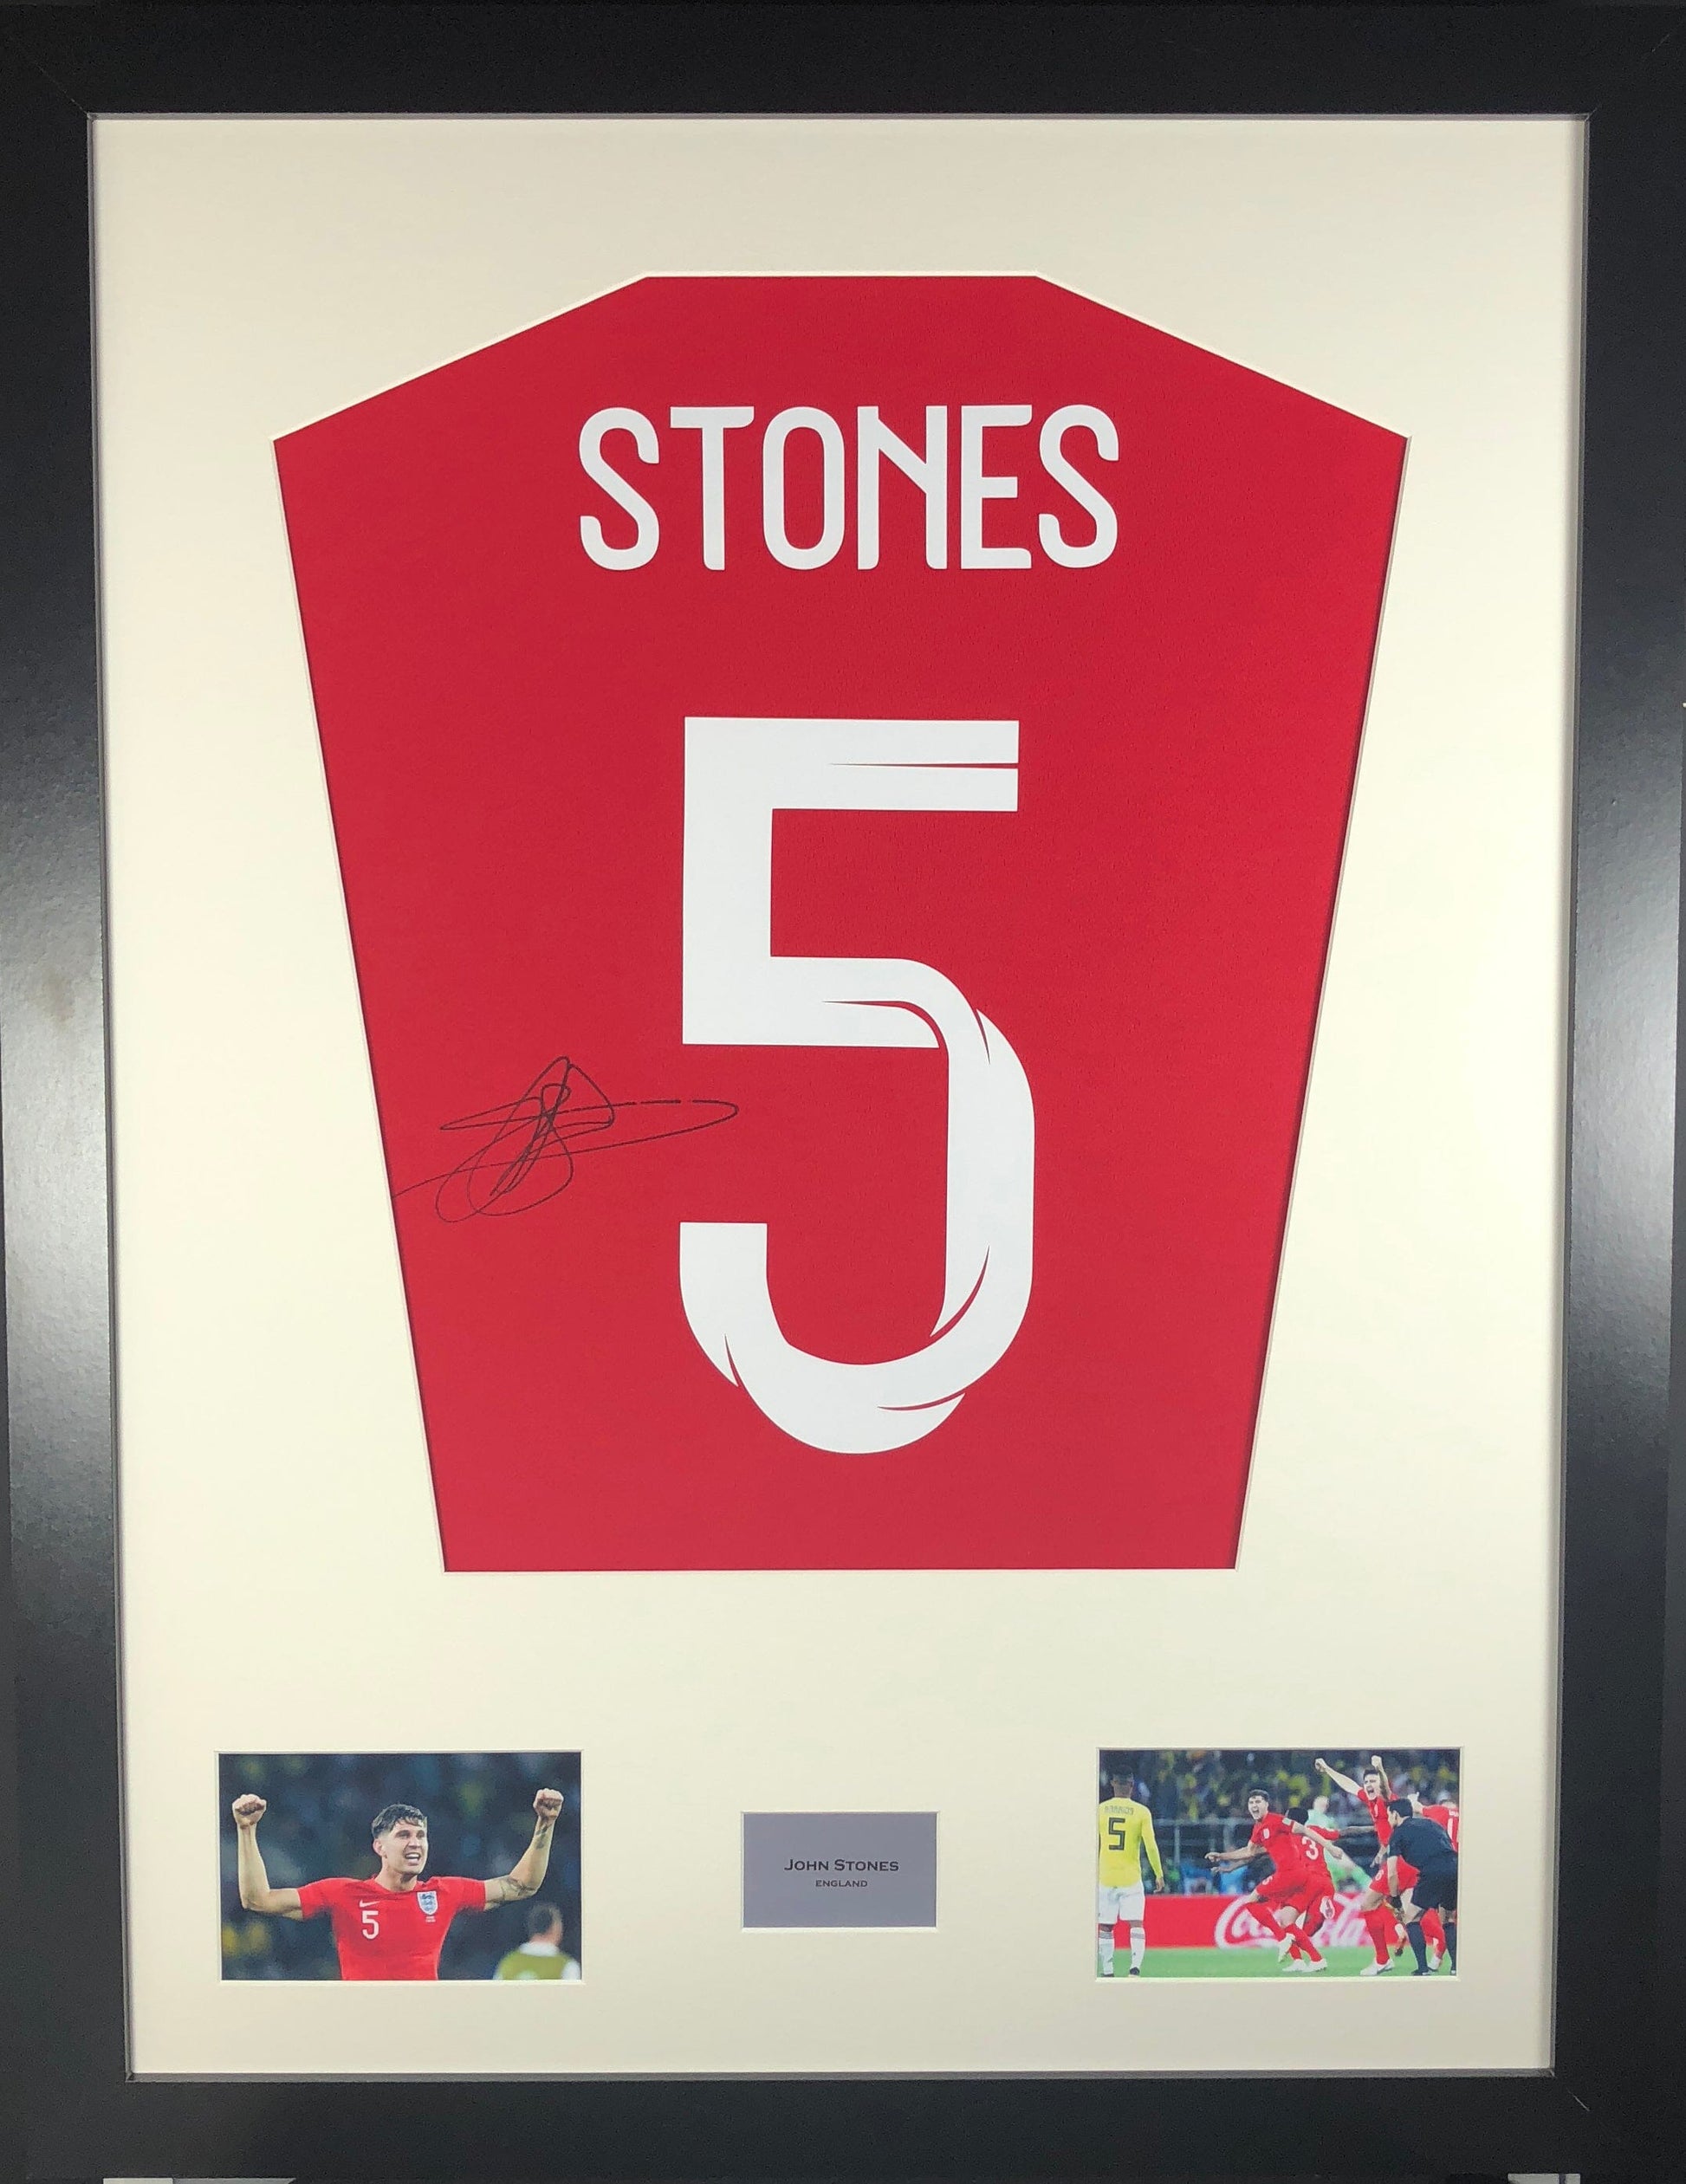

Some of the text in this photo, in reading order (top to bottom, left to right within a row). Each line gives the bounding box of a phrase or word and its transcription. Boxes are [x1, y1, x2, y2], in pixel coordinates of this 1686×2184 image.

[578, 404, 1119, 571] STONES
[679, 716, 1034, 1454] 5
[1108, 1817, 1125, 1851] 5
[1301, 1836, 1319, 1860] 3
[814, 1879, 868, 1888] ENGLAND
[361, 1909, 379, 1940] 5
